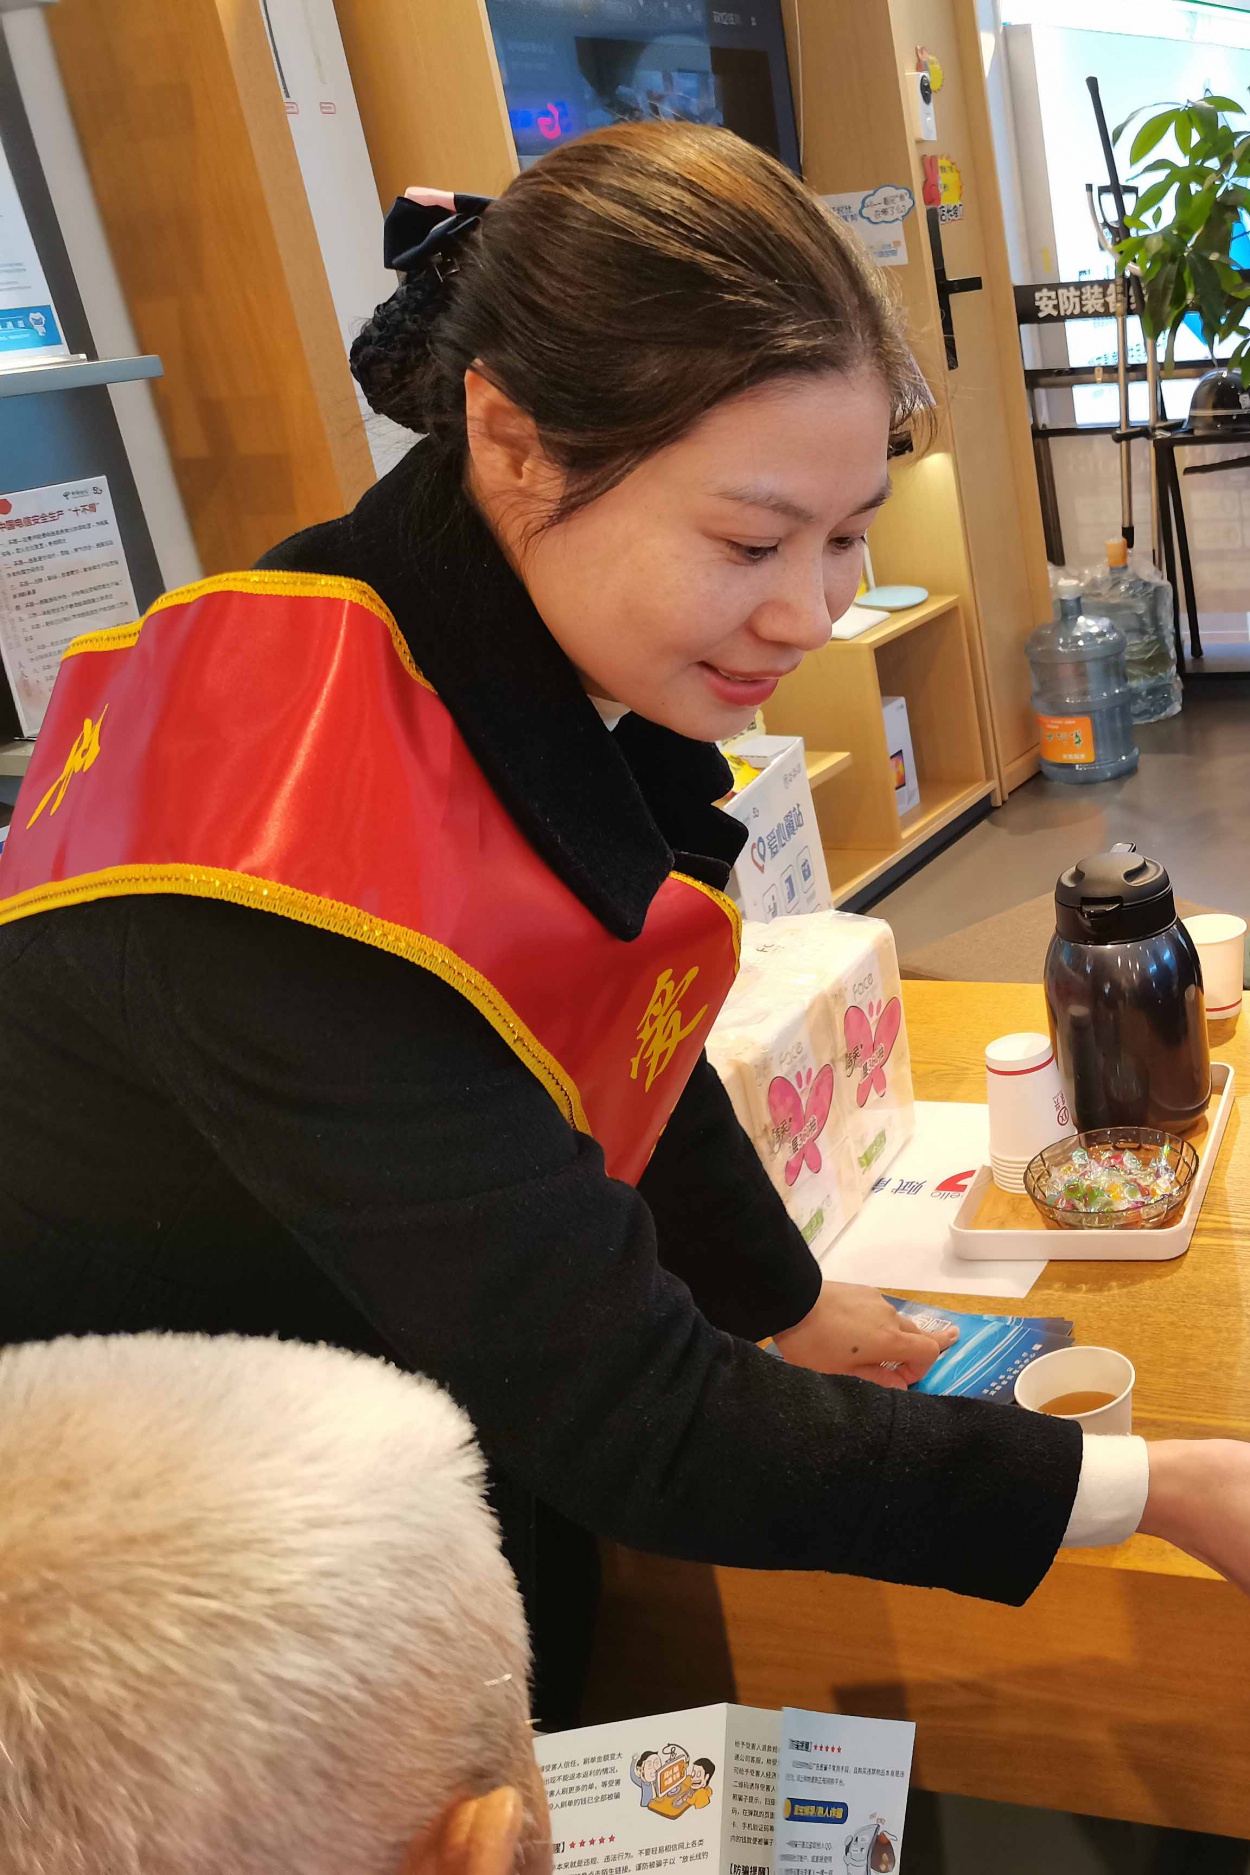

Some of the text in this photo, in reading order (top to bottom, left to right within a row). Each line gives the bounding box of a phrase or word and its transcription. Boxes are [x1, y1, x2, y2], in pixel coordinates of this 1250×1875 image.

[930, 1192, 963, 1200] ello
[547, 1779, 621, 1798] 害人刷更多的单，等受害
[553, 1838, 704, 1870] 本来就是违规、违法行为。不要轻易相信网上各类
